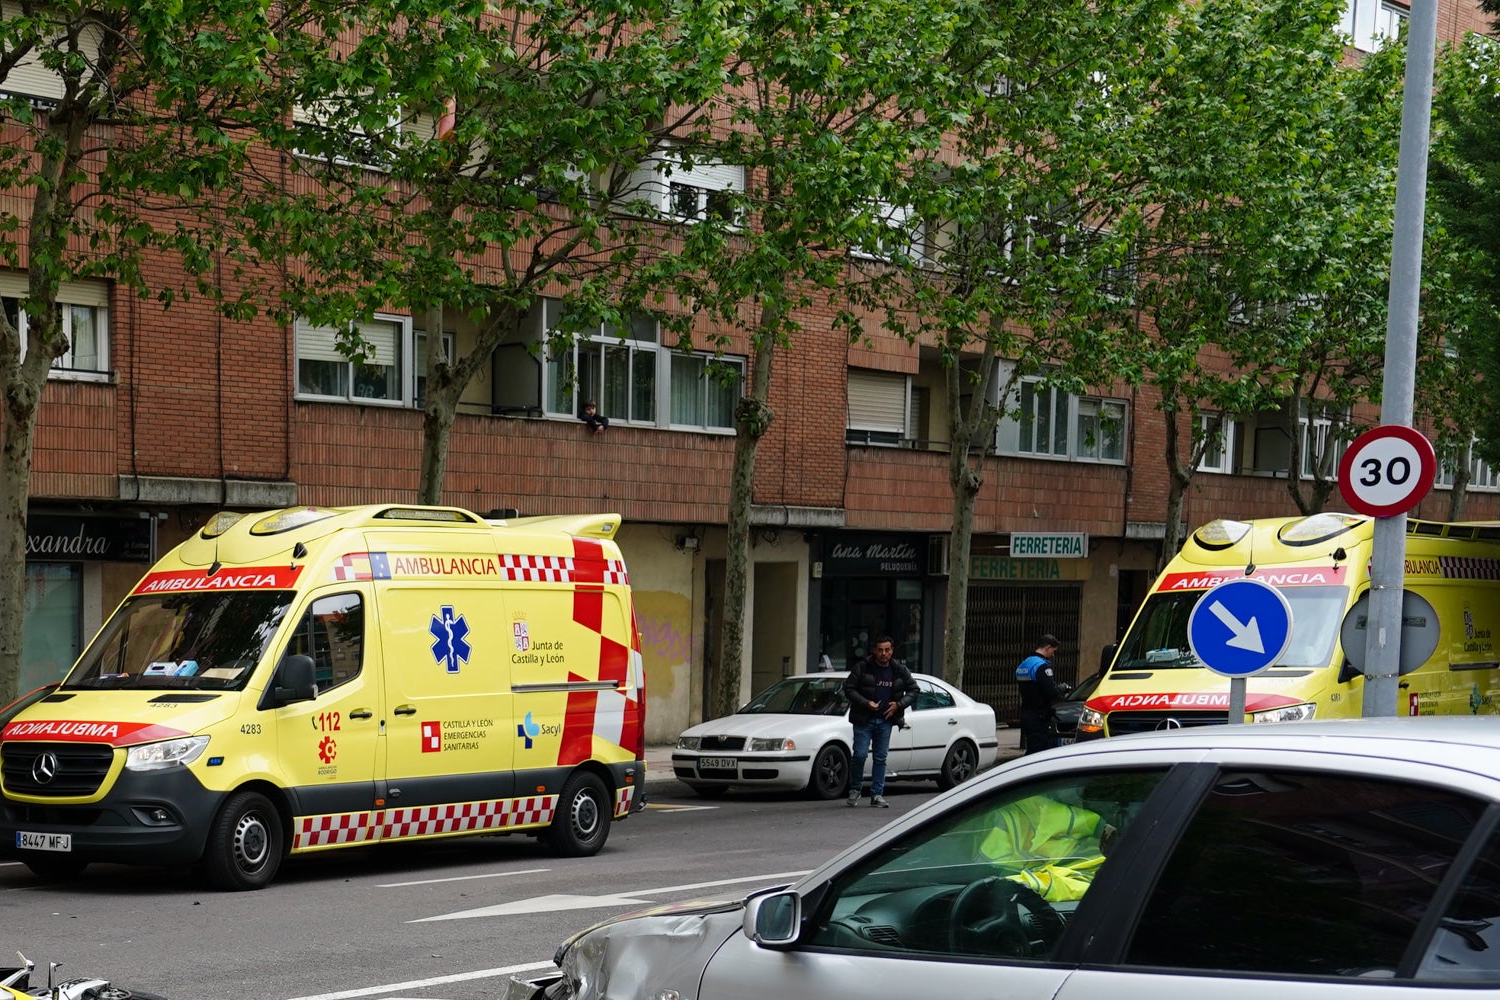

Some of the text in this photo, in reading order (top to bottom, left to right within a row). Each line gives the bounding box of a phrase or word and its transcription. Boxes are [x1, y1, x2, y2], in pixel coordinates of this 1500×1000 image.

[1360, 456, 1411, 487] 30
[1012, 536, 1082, 555] FERRETERIA
[394, 557, 498, 575] AMBULANCIA
[971, 557, 1061, 578] FERRETERIA
[142, 574, 277, 592] AMBULANCIA
[532, 640, 564, 651] Junta de
[511, 652, 565, 667] Castilla y León
[240, 723, 262, 735] 4283
[319, 711, 341, 732] 112
[442, 719, 494, 729] CASTILLA Y LEÓN
[443, 730, 487, 740] EMERGENCIAS
[541, 723, 561, 737] Sacyl
[443, 742, 479, 751] SANITARIAS
[701, 758, 720, 768] 5549
[22, 834, 69, 849] 8447 MFJ
